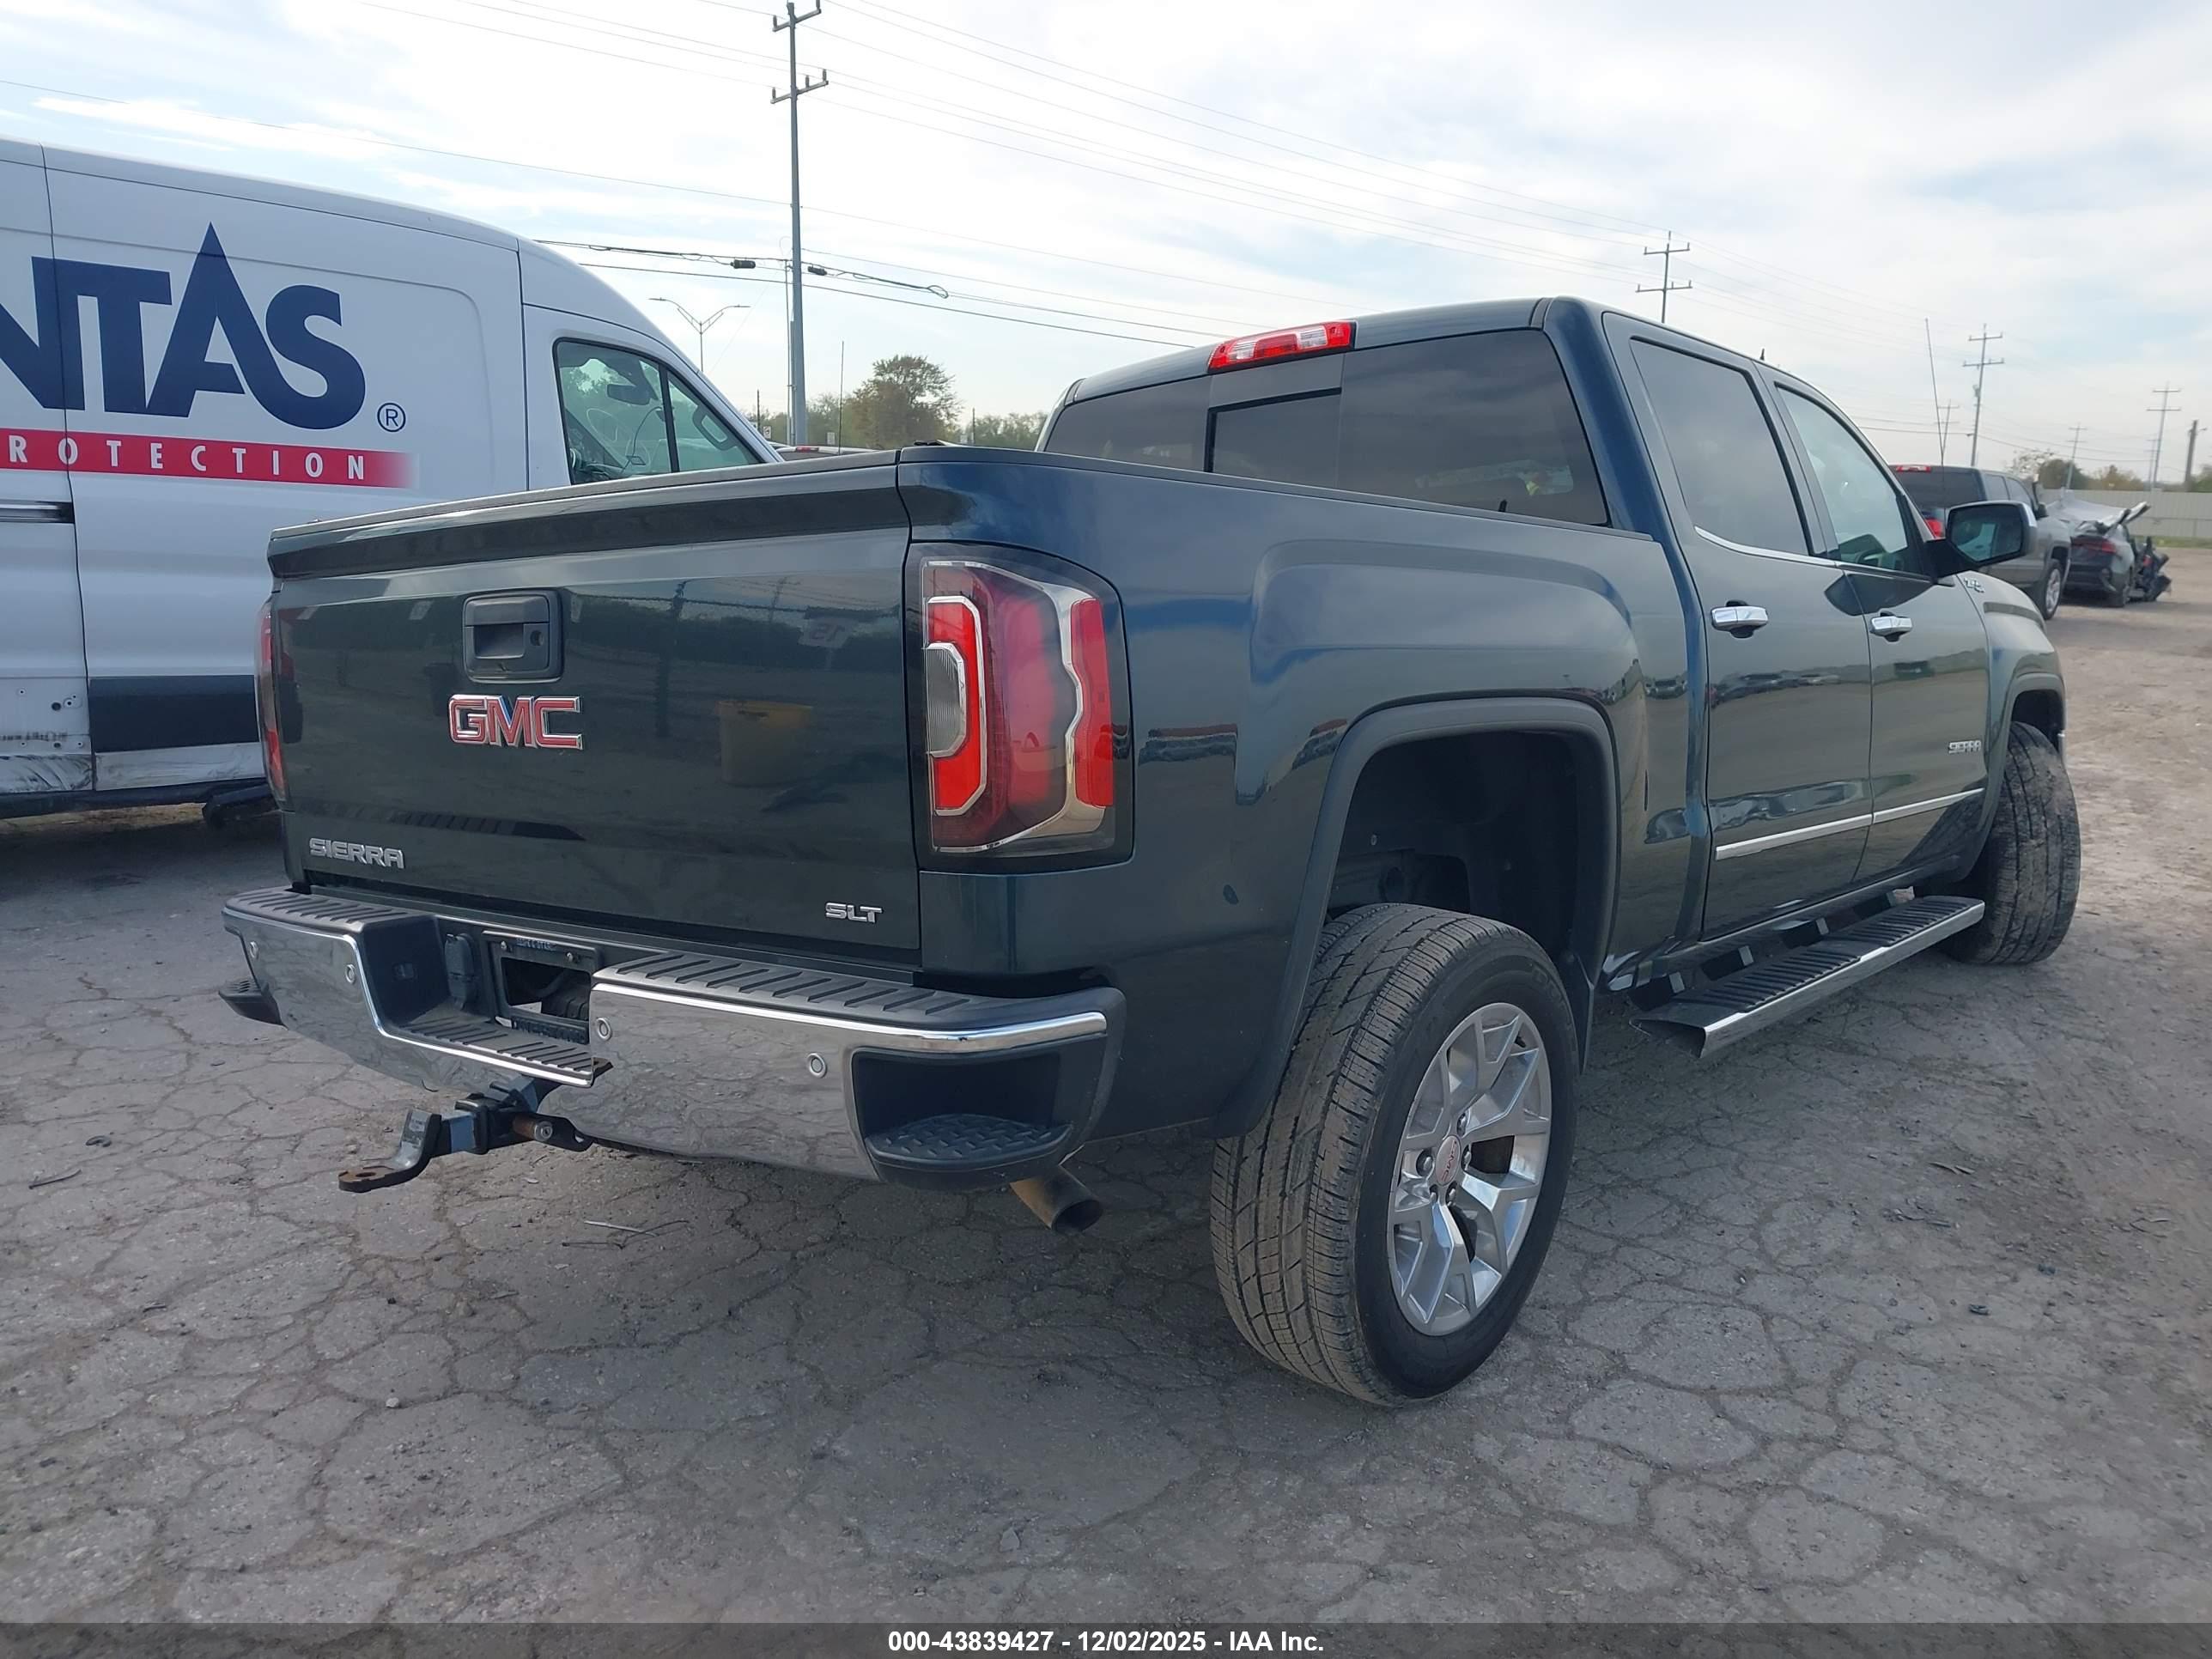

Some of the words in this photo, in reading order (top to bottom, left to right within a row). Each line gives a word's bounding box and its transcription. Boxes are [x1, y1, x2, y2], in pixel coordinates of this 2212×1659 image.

[9, 434, 365, 481] ROTECTION
[448, 694, 583, 750] GMC
[309, 837, 404, 869] SIERRA
[825, 902, 883, 923] SLT
